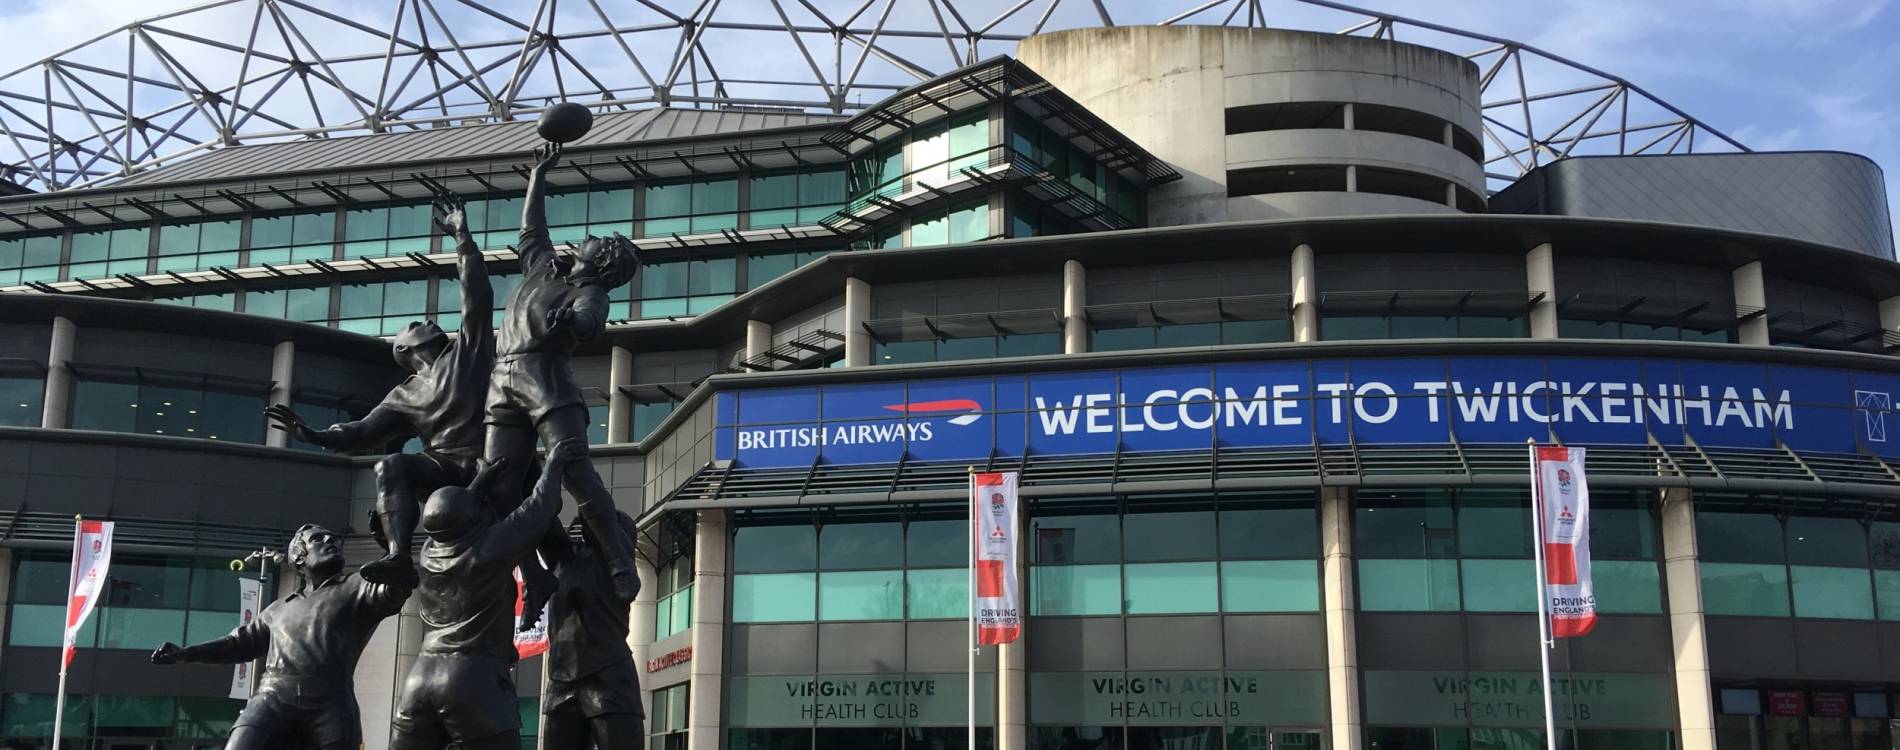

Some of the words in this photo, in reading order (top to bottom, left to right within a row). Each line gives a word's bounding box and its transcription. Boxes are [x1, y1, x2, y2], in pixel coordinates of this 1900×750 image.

[1035, 384, 1302, 436] WELCOME
[1317, 382, 1398, 424] TO
[1413, 381, 1794, 430] TWICKENHAM
[738, 427, 827, 450] BRITISH
[833, 422, 933, 445] AIRWAYS
[1553, 596, 1595, 606] DRIVING
[981, 609, 1017, 617] DRIVING
[786, 680, 857, 696] VIRGIN
[866, 680, 935, 695] ACTIVE
[1092, 678, 1170, 694] VIRGIN
[1181, 678, 1257, 693] ACTIVE
[1433, 677, 1516, 694] VIRGIN
[801, 704, 866, 719] HEALTH
[873, 704, 919, 719] CLUB
[1110, 702, 1182, 718] HEALTH
[1191, 702, 1240, 718] CLUB
[1454, 703, 1529, 719] HEATH
